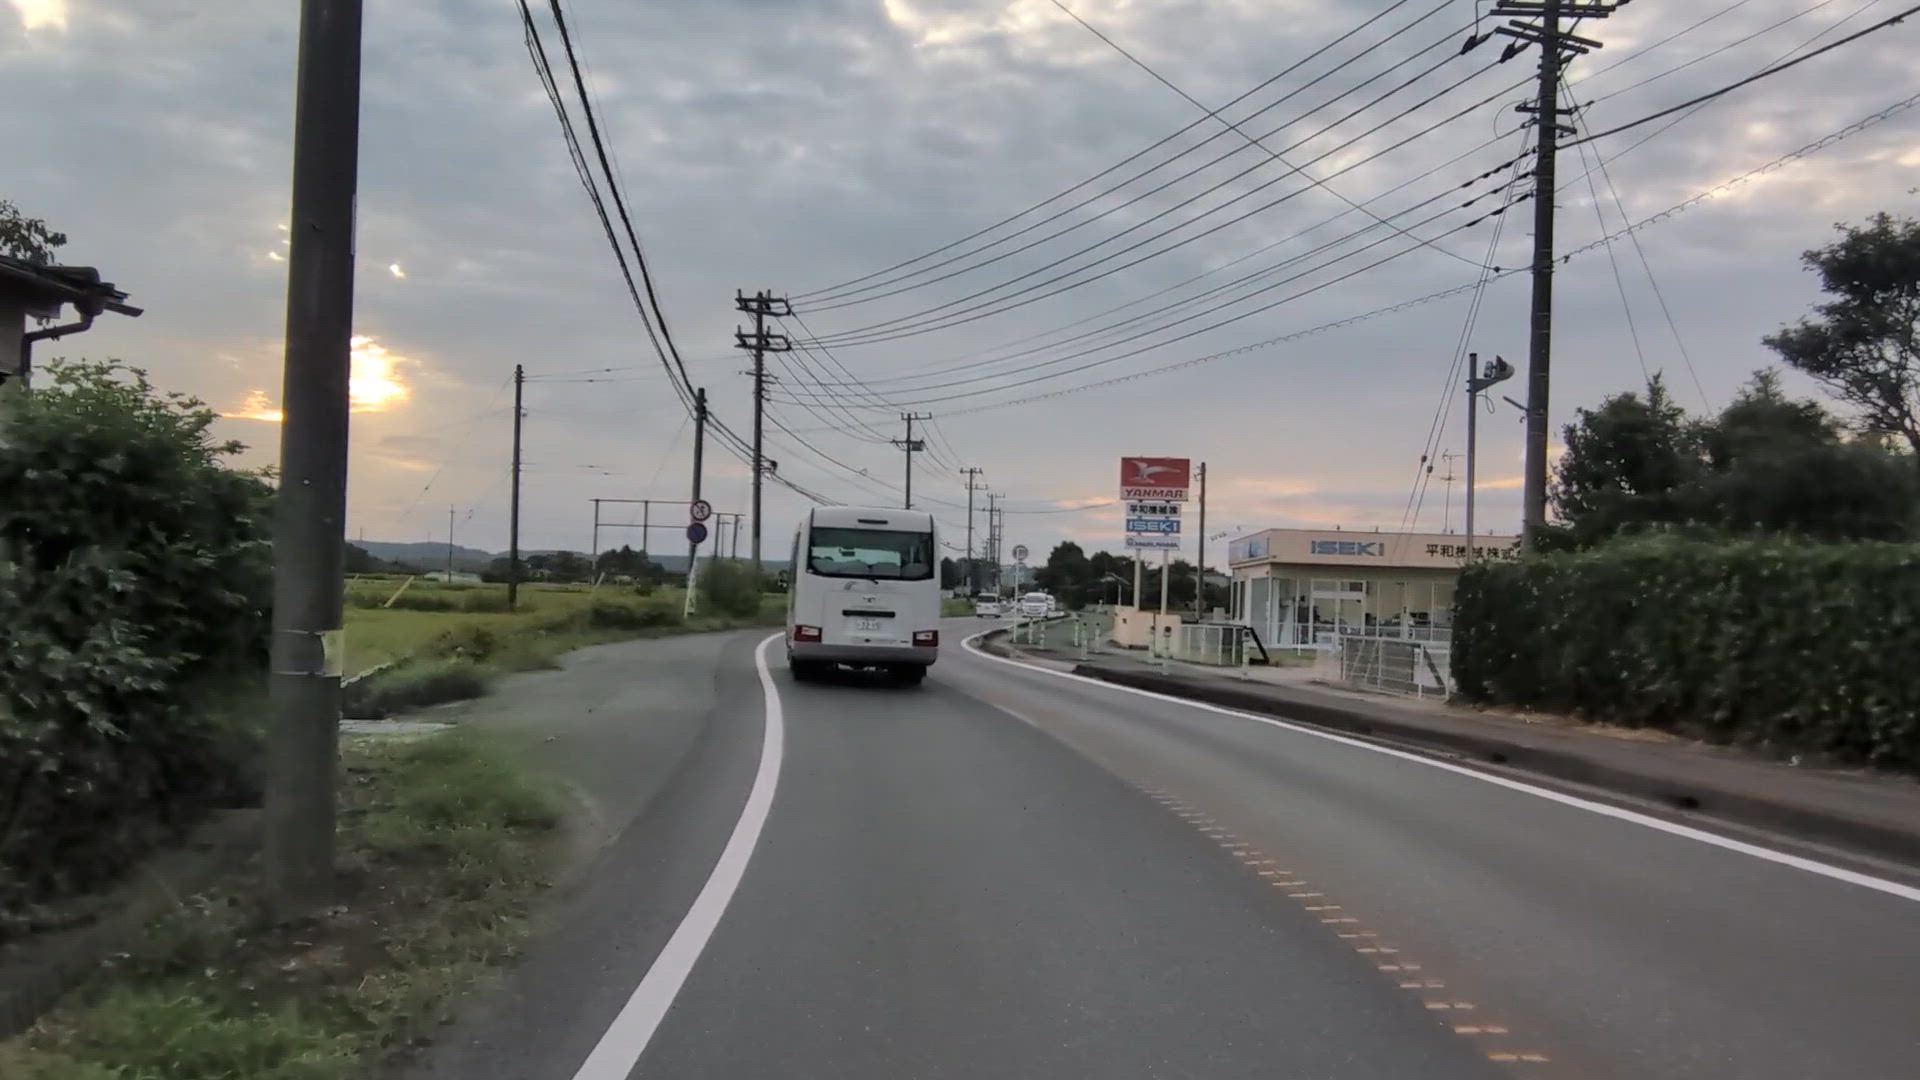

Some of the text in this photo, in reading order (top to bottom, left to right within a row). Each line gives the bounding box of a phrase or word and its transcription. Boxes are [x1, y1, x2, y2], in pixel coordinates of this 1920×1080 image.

[1125, 488, 1183, 498] YANMAR
[1128, 521, 1177, 532] ISEKI
[1311, 540, 1384, 556] ISEKI
